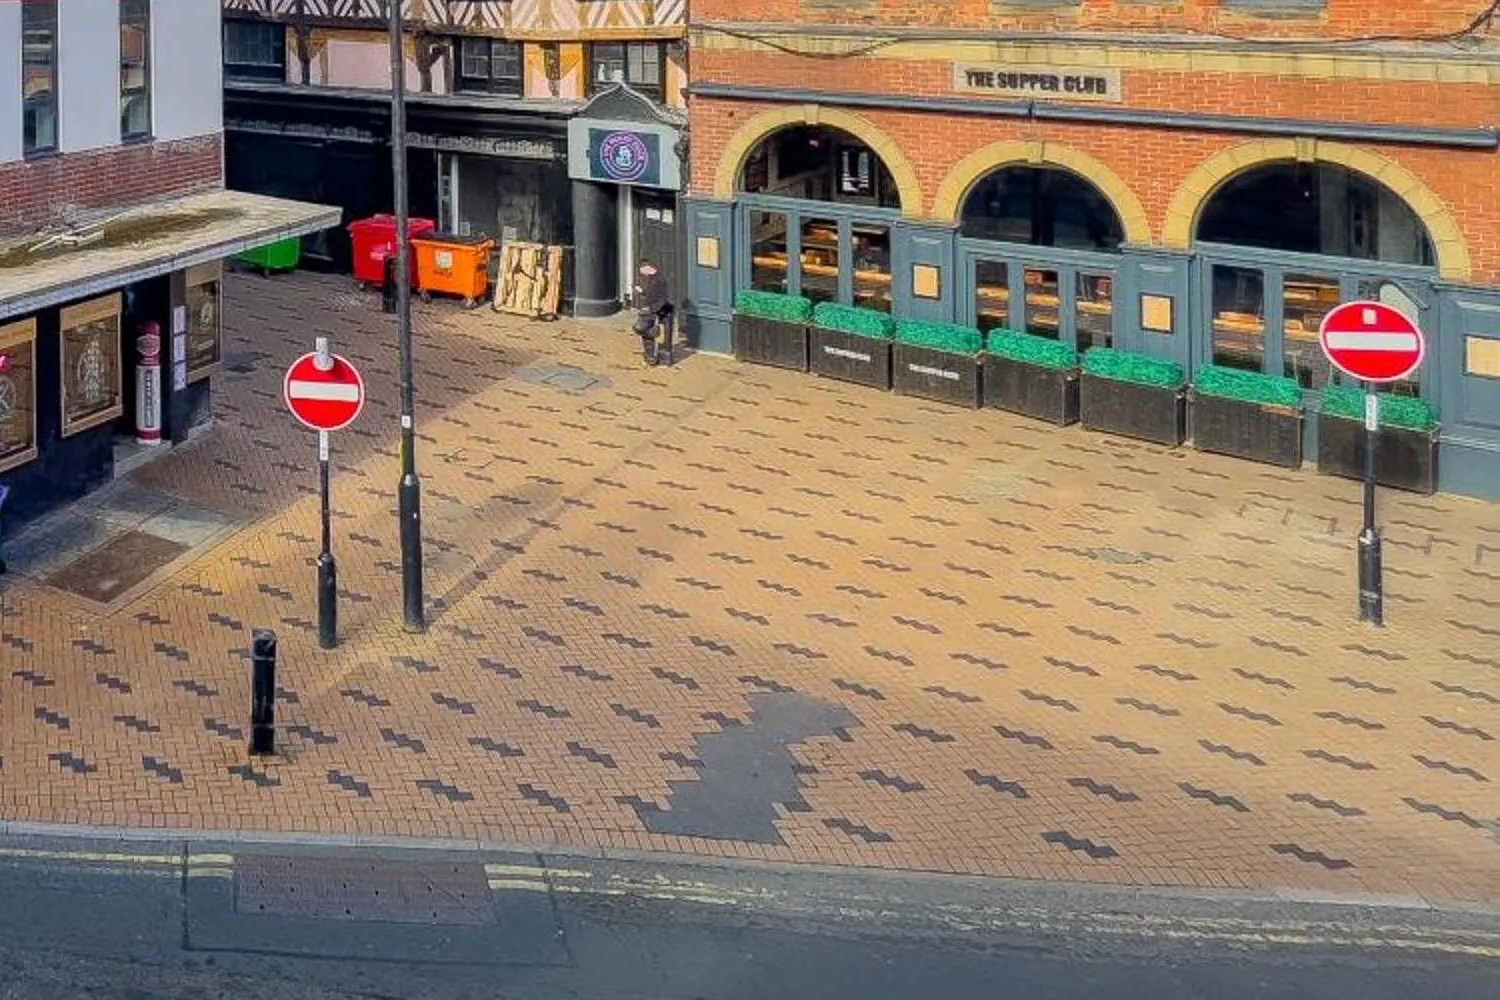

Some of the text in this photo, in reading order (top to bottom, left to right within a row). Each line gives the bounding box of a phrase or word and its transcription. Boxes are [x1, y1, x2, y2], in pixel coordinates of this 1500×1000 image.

[965, 71, 1107, 94] THE SUPPER CLUB
